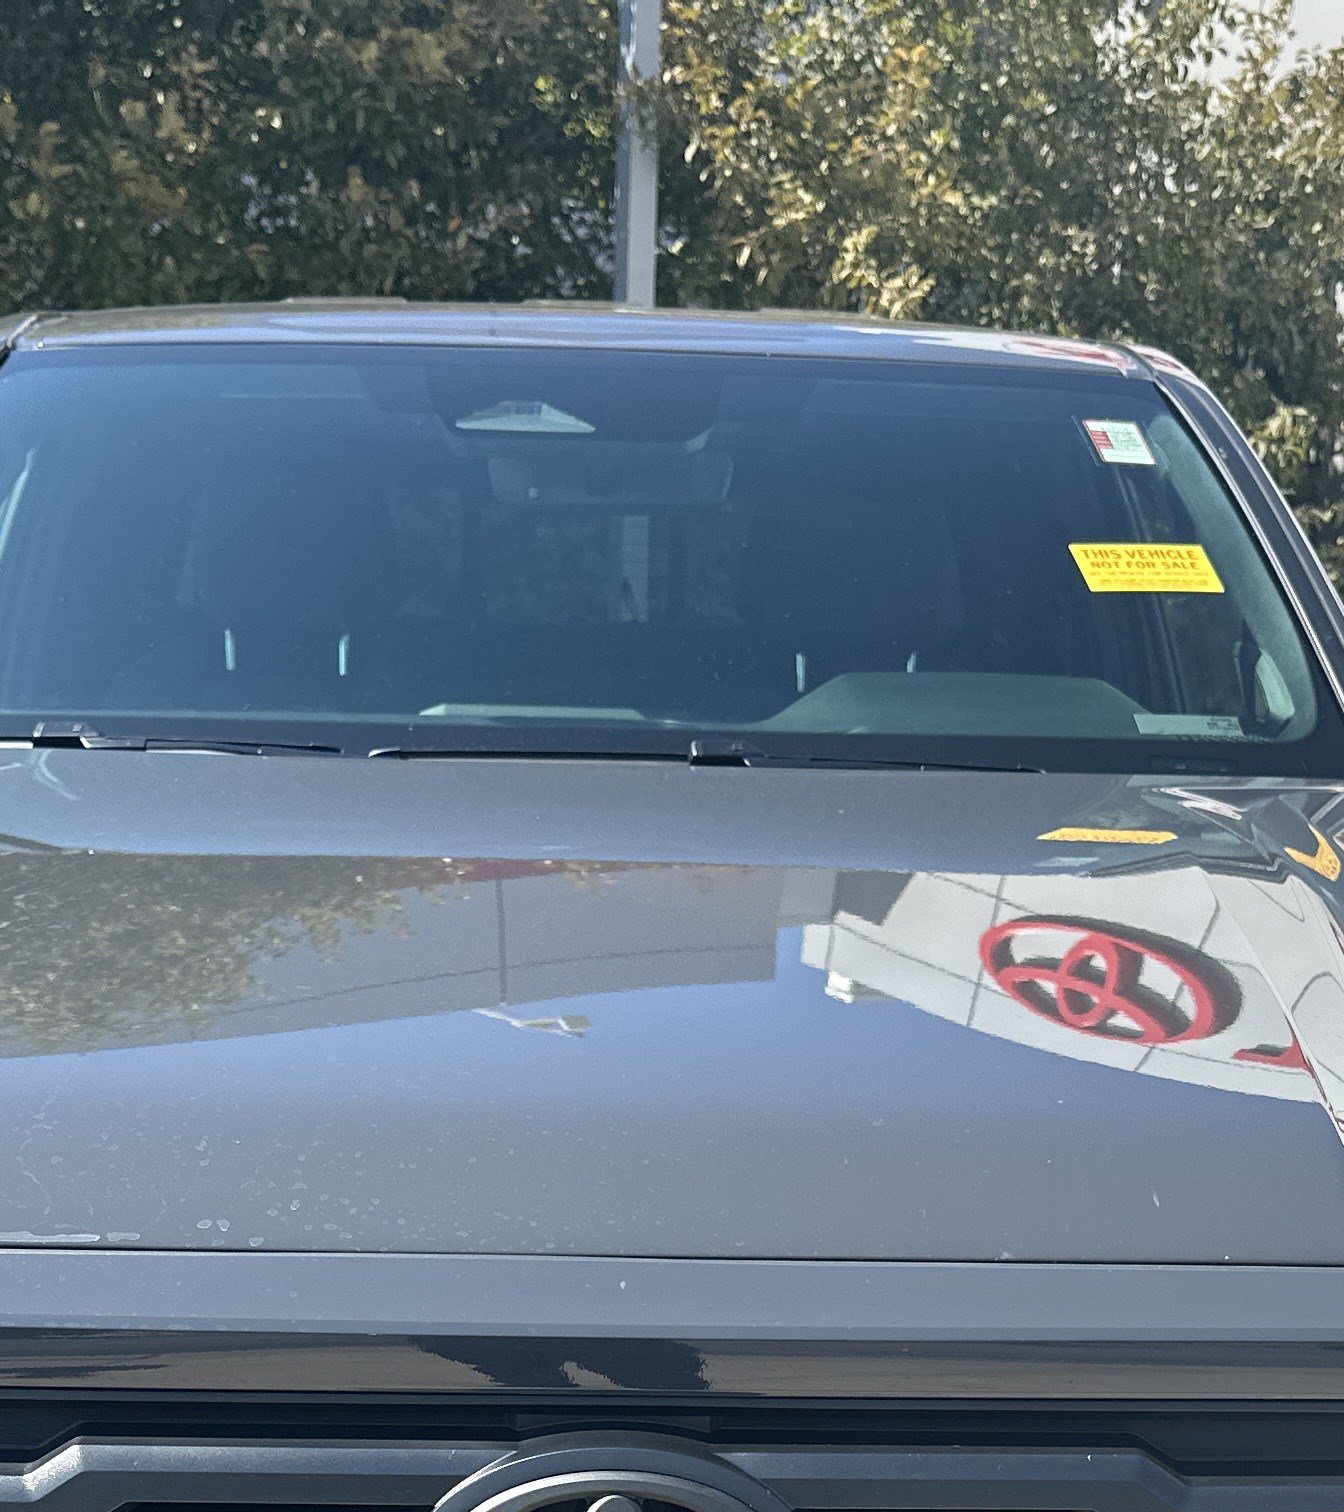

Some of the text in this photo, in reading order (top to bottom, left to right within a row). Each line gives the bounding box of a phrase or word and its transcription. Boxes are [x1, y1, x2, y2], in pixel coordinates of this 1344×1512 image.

[1081, 549, 1199, 561] THIS VEHICLE
[1089, 561, 1200, 570] NOT FOR SALE
